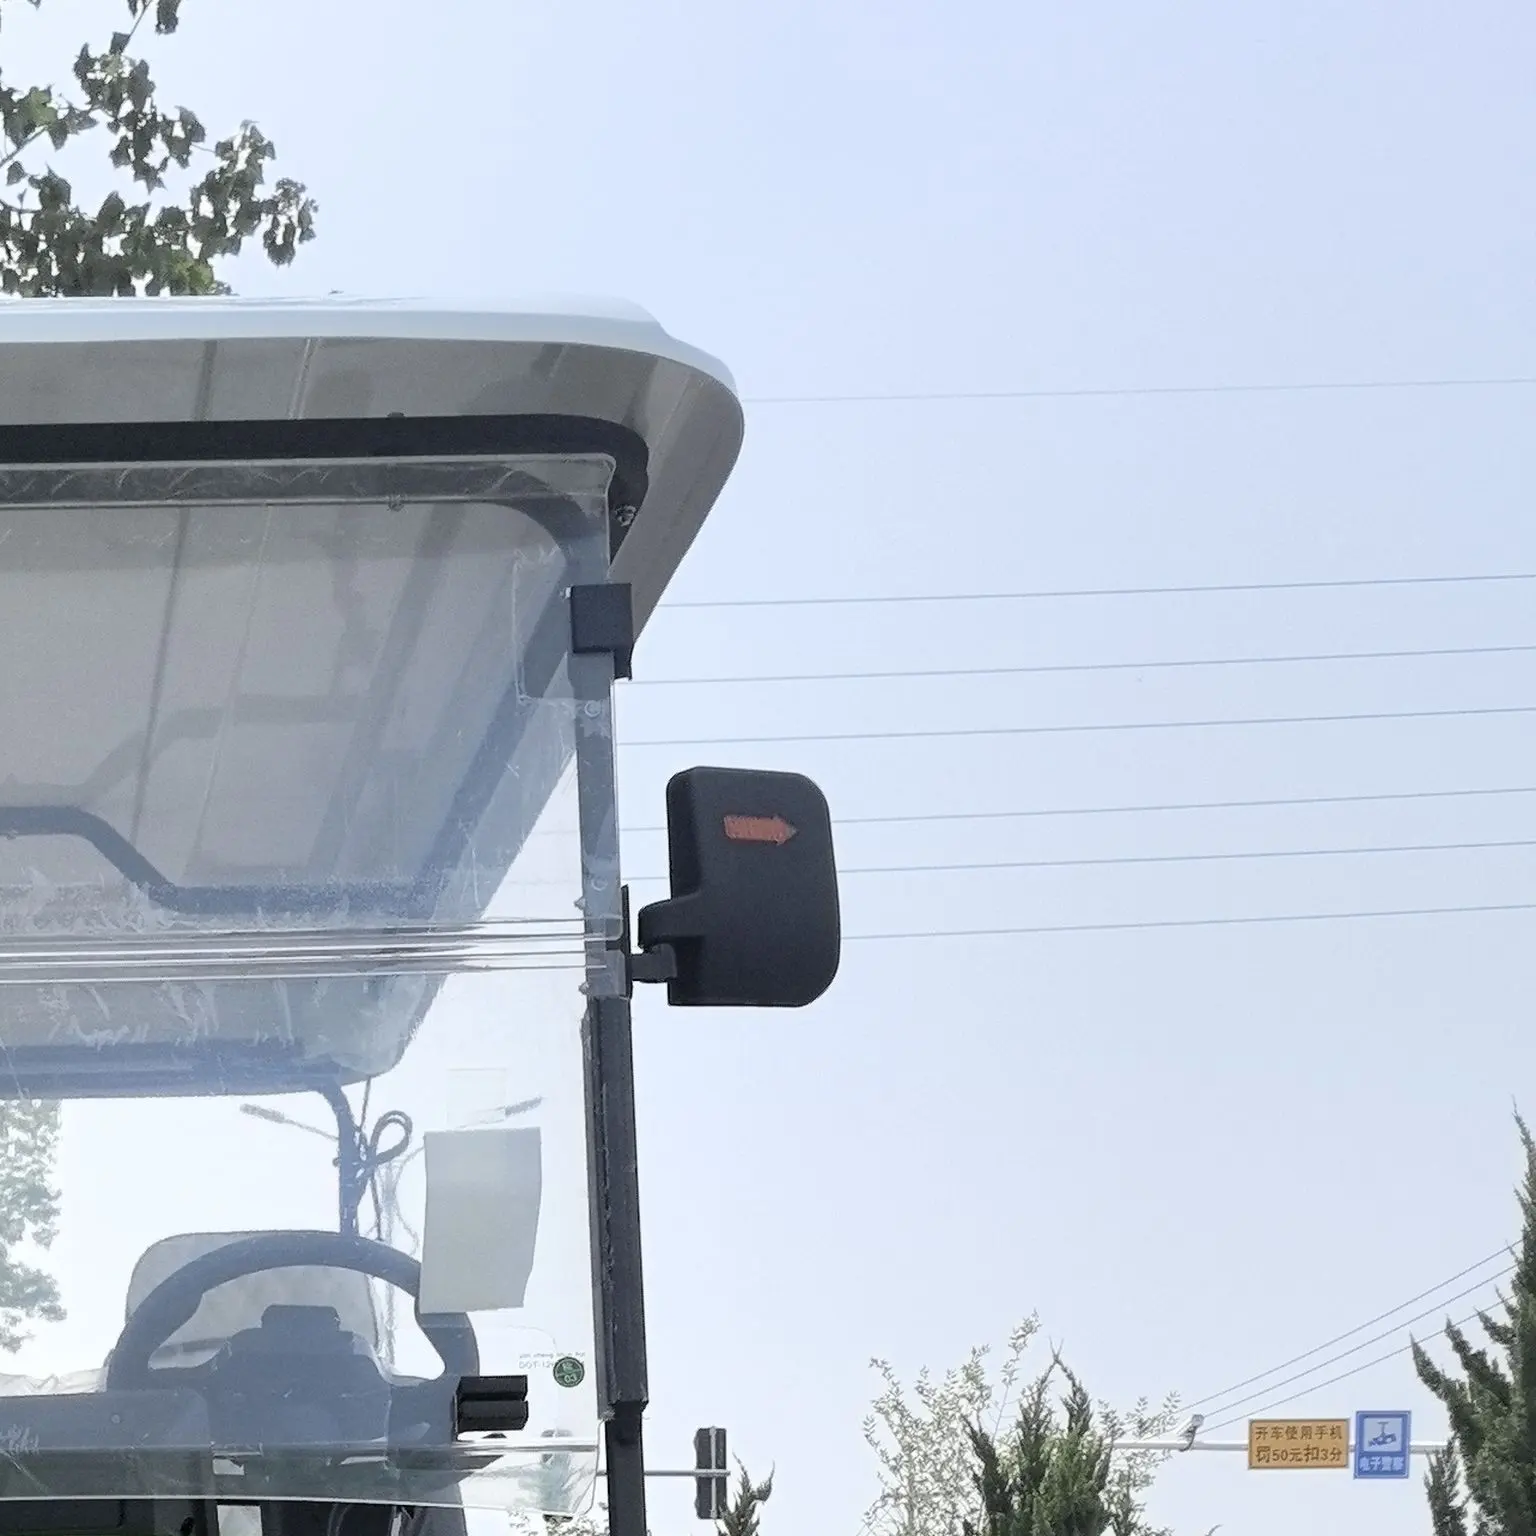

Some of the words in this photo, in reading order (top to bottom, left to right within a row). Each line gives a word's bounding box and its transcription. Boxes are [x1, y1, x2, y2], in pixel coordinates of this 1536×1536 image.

[1255, 1425, 1343, 1441] 开车使用手机
[1256, 1444, 1343, 1463] 罚50元扣3分
[1359, 1456, 1405, 1472] 电子警察
